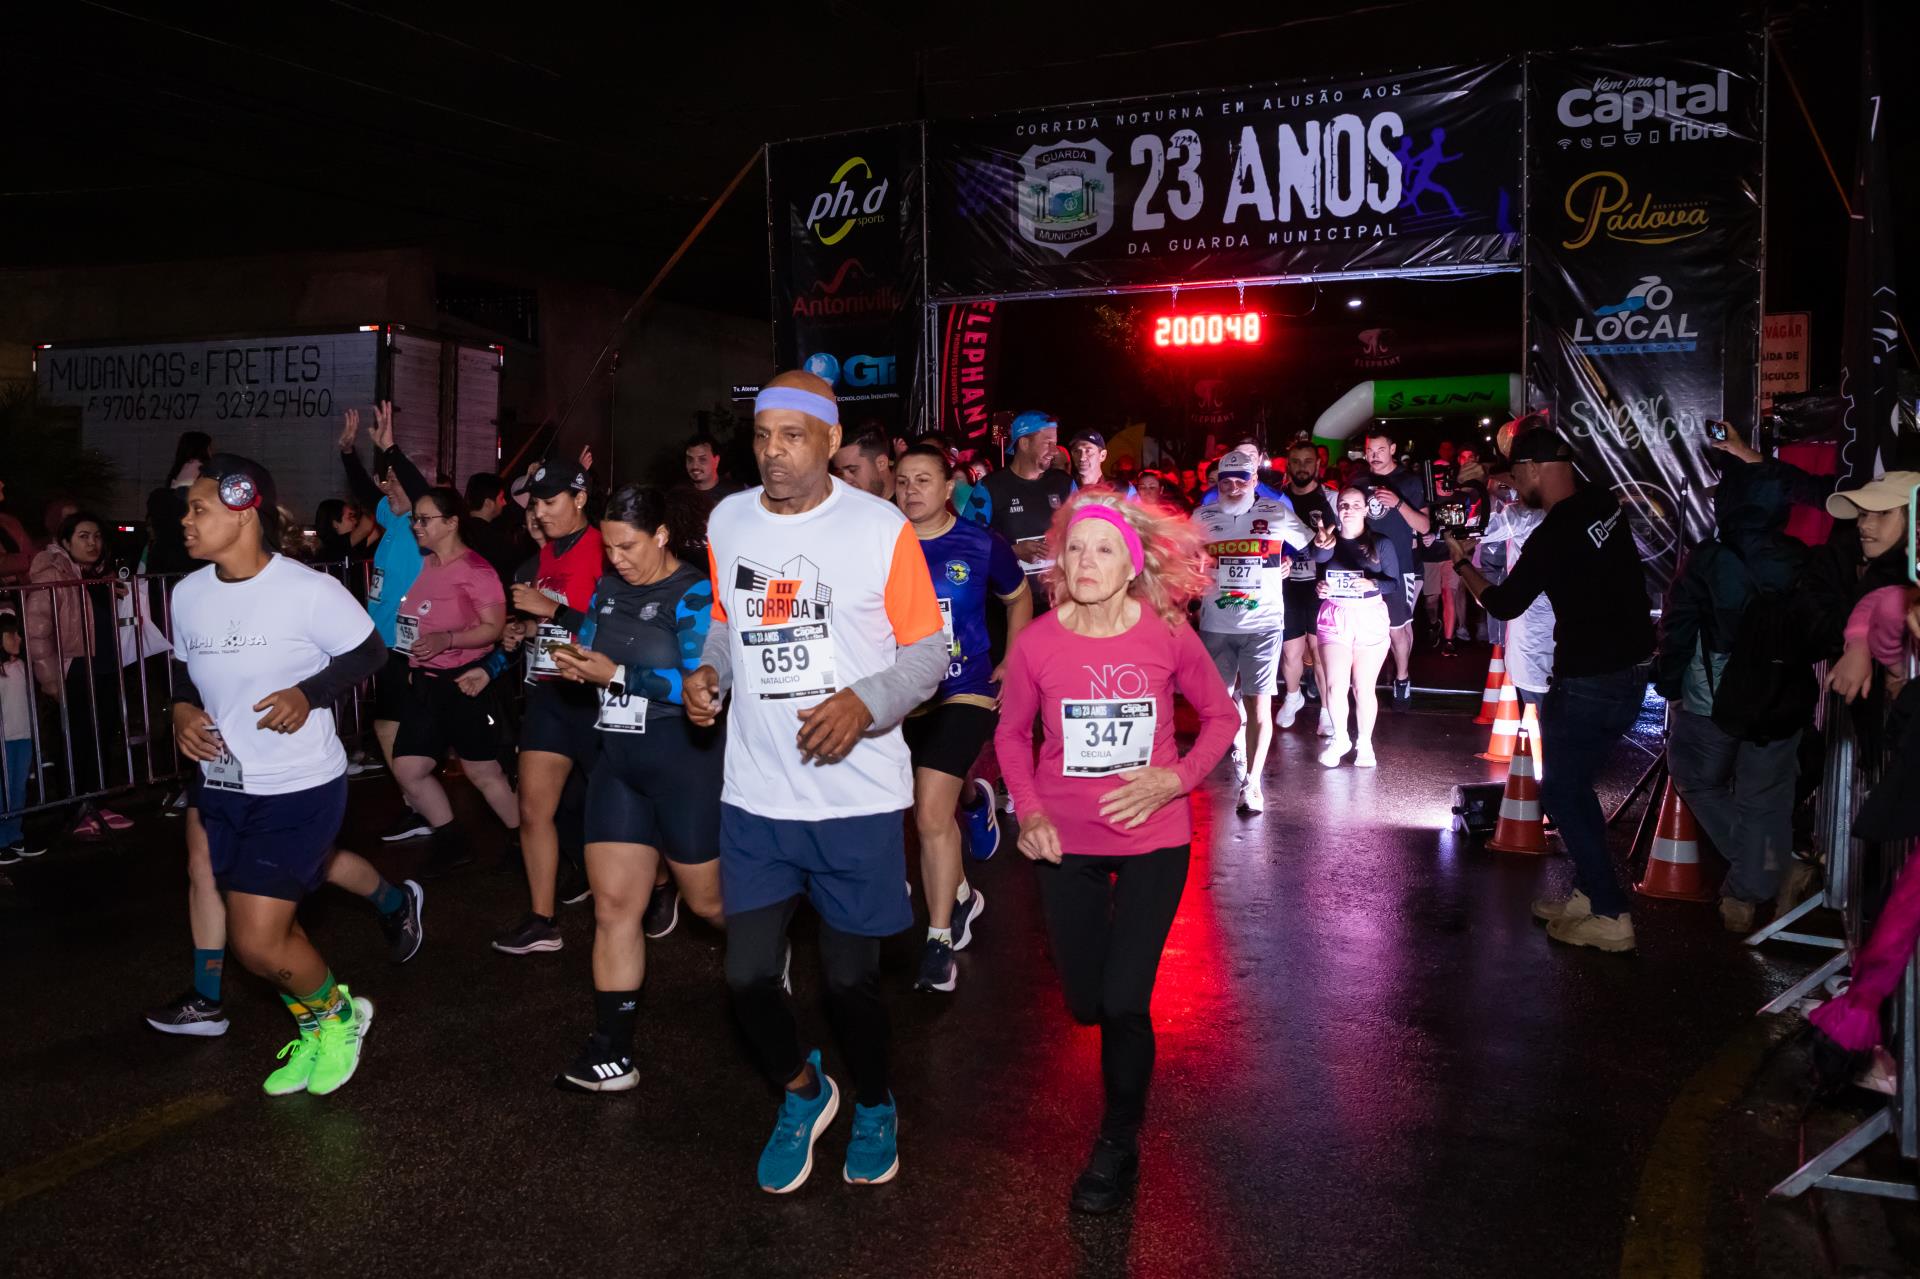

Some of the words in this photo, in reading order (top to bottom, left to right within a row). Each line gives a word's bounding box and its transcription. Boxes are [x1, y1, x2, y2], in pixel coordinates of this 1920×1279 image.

[1593, 76, 1622, 92] Vem
[1623, 77, 1654, 93] pra
[1016, 118, 1099, 136] CORRIDA
[1116, 106, 1204, 126] NOTURNA
[1222, 101, 1245, 115] EM
[1263, 88, 1343, 110] ALUSÃO
[1363, 84, 1401, 99] AOS
[1557, 73, 1728, 131] Capital
[1042, 150, 1087, 163] GUARDA
[1131, 128, 1205, 231] 23
[1222, 111, 1404, 224] ANOS
[806, 178, 889, 231] ph.d
[856, 215, 885, 230] sports
[1039, 227, 1092, 241] MUNICIPAL
[1128, 240, 1151, 255] DA
[1169, 233, 1250, 252] GUARDA
[1268, 223, 1397, 244] MUNICIPAL
[1573, 313, 1699, 342] LOCAL
[190, 361, 200, 376] e
[206, 346, 321, 384] FRETES
[1786, 351, 1800, 360] DE
[103, 393, 200, 421] 97062437
[216, 388, 332, 419] 32929460
[1229, 566, 1251, 578] 627
[776, 583, 793, 594] III
[746, 598, 811, 619] CORRIDA
[762, 644, 810, 674] 659
[760, 675, 800, 685] NATALICIO
[1082, 705, 1090, 716] 23
[1091, 705, 1108, 716] ANOS
[1120, 704, 1149, 715] Capital
[1085, 721, 1134, 747] 347
